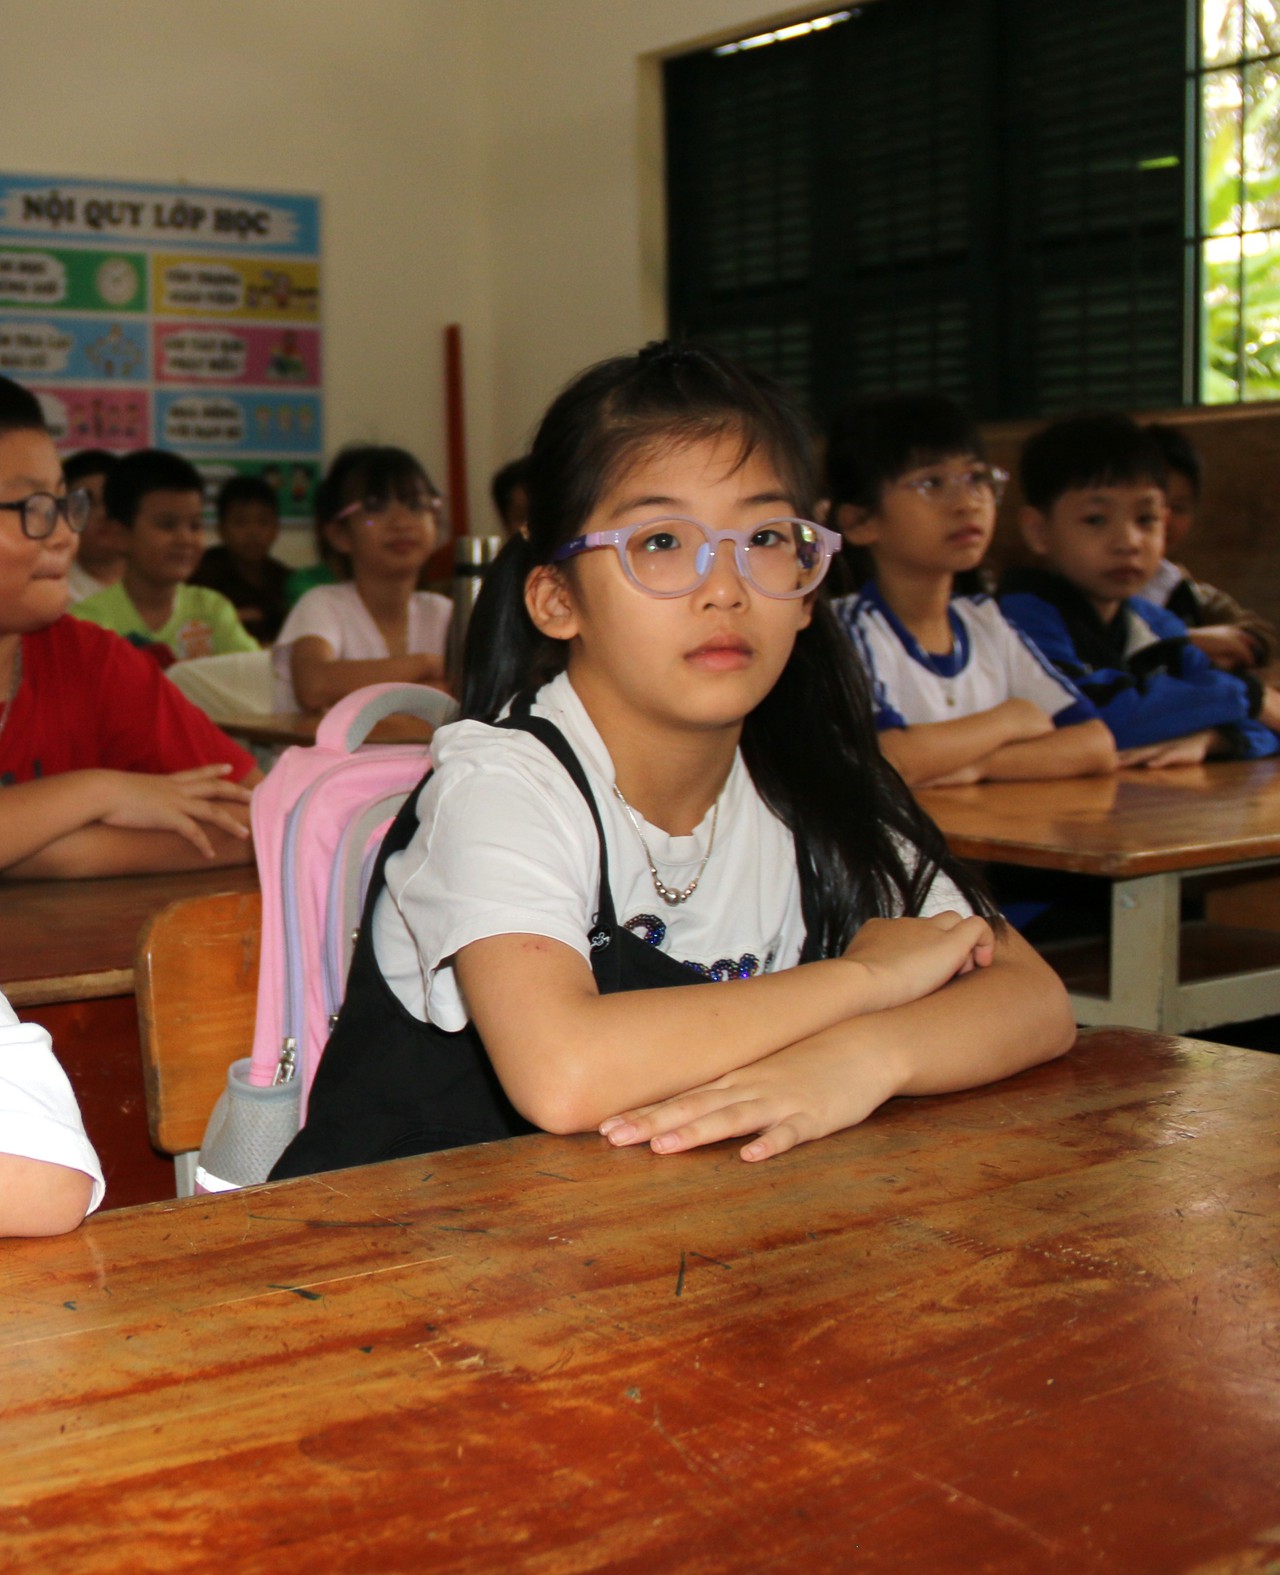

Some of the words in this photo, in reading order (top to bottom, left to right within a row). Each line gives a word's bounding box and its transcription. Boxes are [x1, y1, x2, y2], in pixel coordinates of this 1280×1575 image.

[22, 189, 76, 228] NỘI
[83, 199, 145, 231] QUY
[153, 198, 206, 234] LỚP
[213, 206, 272, 243] HỌC
